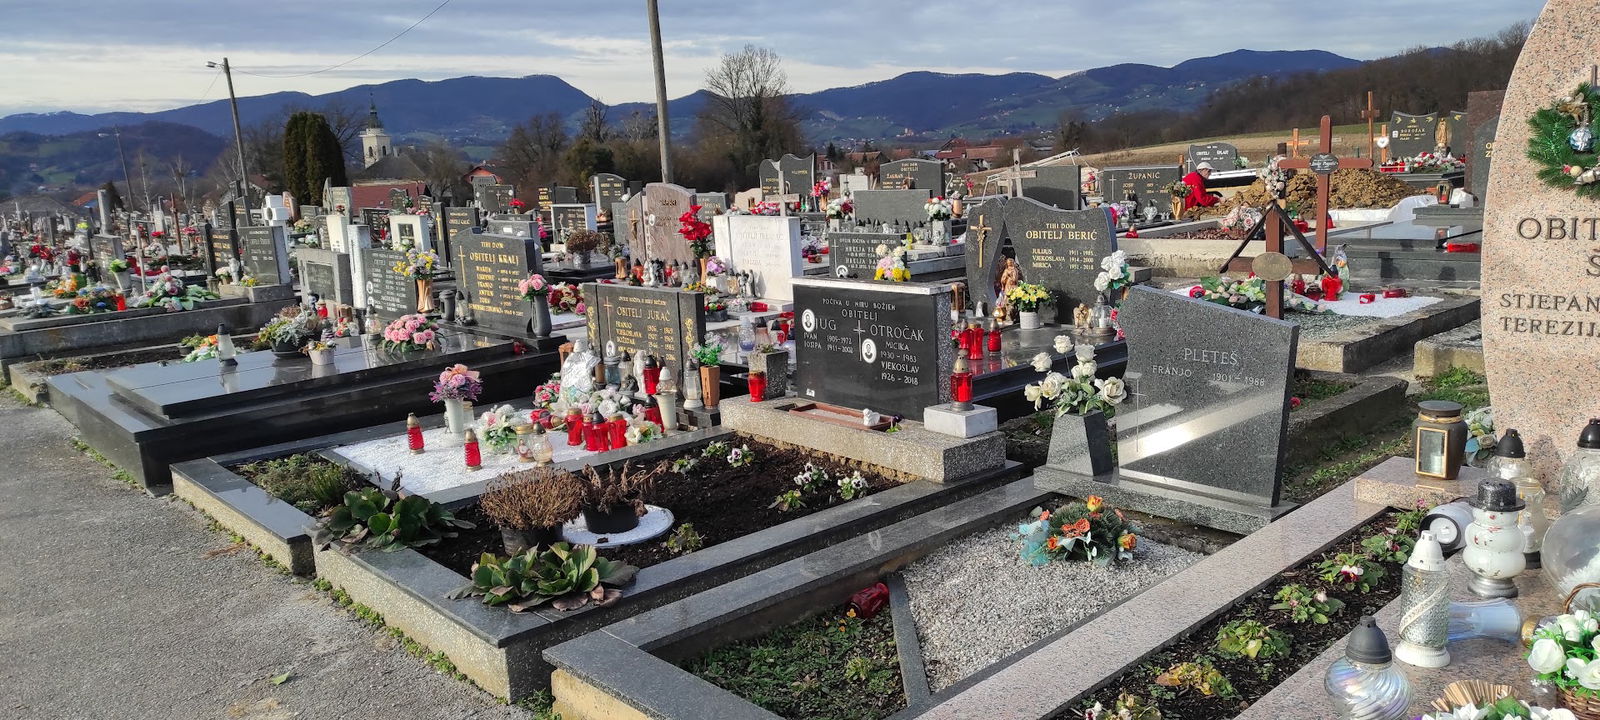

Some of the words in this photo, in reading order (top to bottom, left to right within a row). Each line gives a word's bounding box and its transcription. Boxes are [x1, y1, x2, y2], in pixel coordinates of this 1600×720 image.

[1025, 230, 1063, 240] OBITELJ
[1068, 229, 1098, 241] BERIĆ
[469, 252, 496, 265] OBITELJ
[1499, 293, 1600, 313] STJEPAN
[616, 306, 642, 318] OBITELJ
[841, 308, 879, 322] OBITELJ
[814, 317, 837, 331] JUG
[869, 323, 925, 342] OTROČAK
[1499, 316, 1600, 338] TEREZIJ
[1183, 347, 1238, 366] PLETEŠ
[880, 360, 920, 374] VJEKOSLAV
[1152, 364, 1192, 378] FRANJO
[881, 372, 896, 382] 1926
[903, 376, 919, 386] 2018
